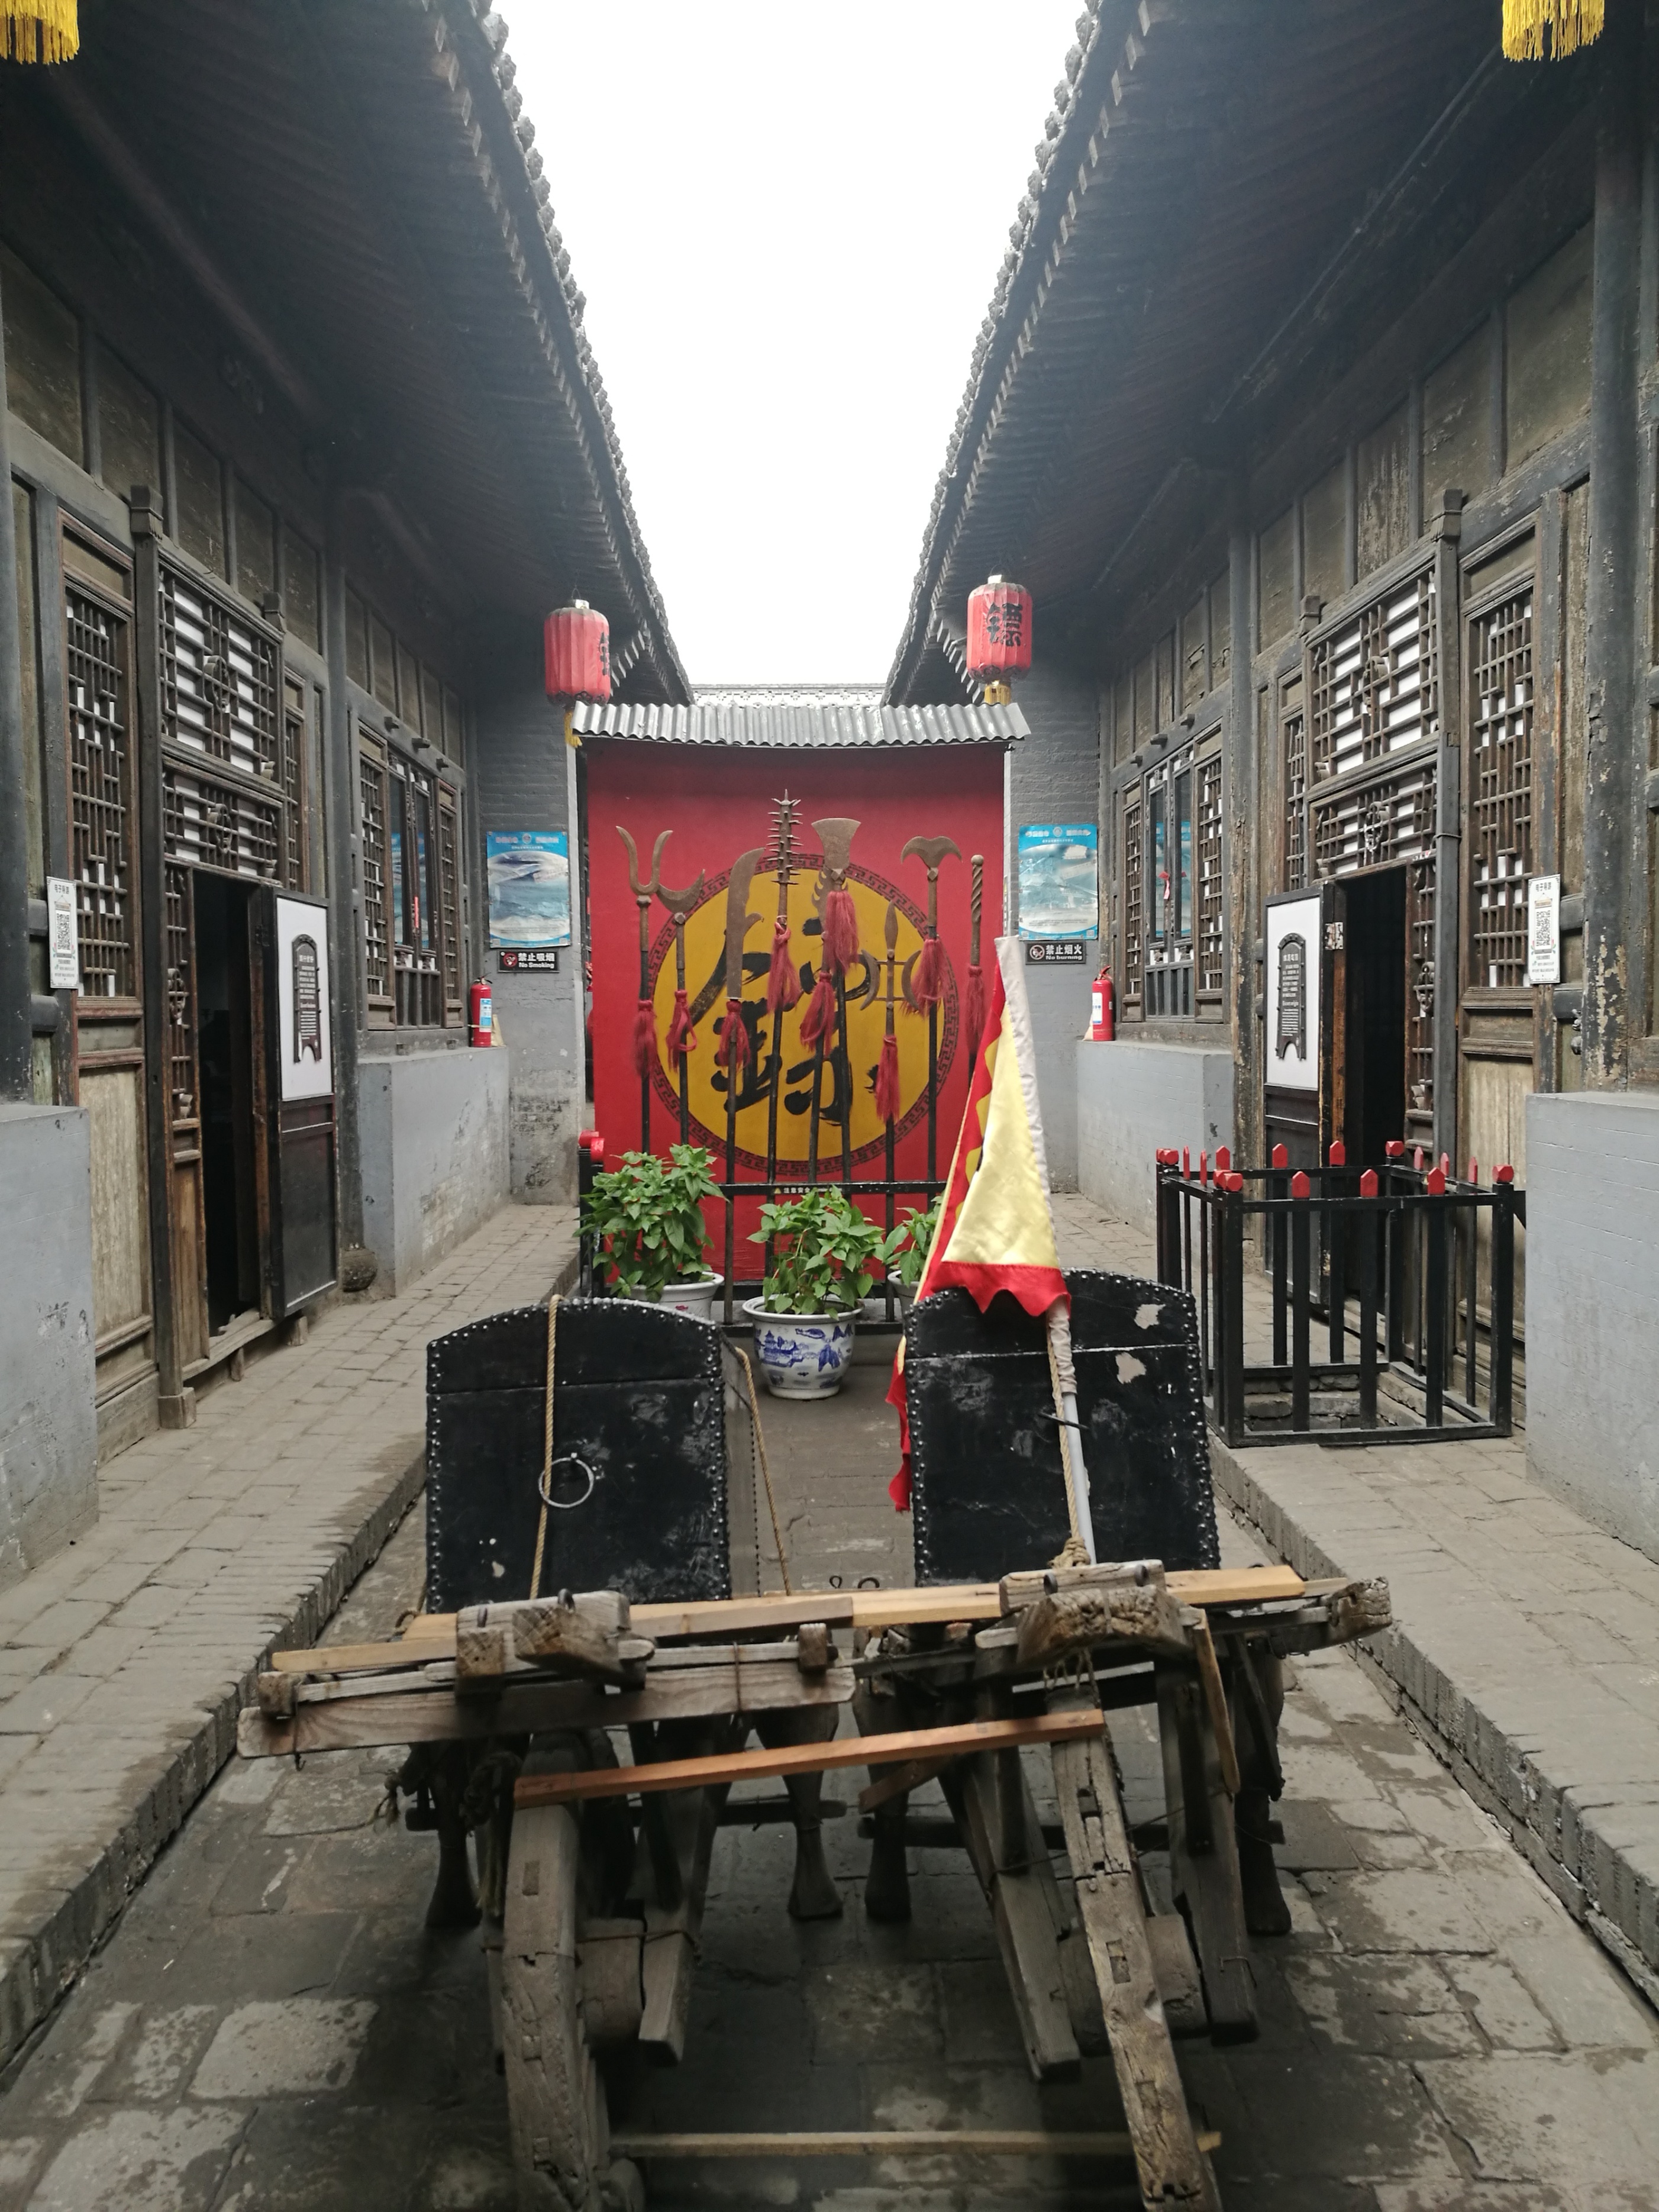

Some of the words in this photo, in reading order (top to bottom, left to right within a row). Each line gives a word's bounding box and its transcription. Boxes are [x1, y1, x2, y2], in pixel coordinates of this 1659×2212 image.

[1045, 944, 1083, 955] 禁止烟火
[518, 952, 555, 962] 禁止吸烟
